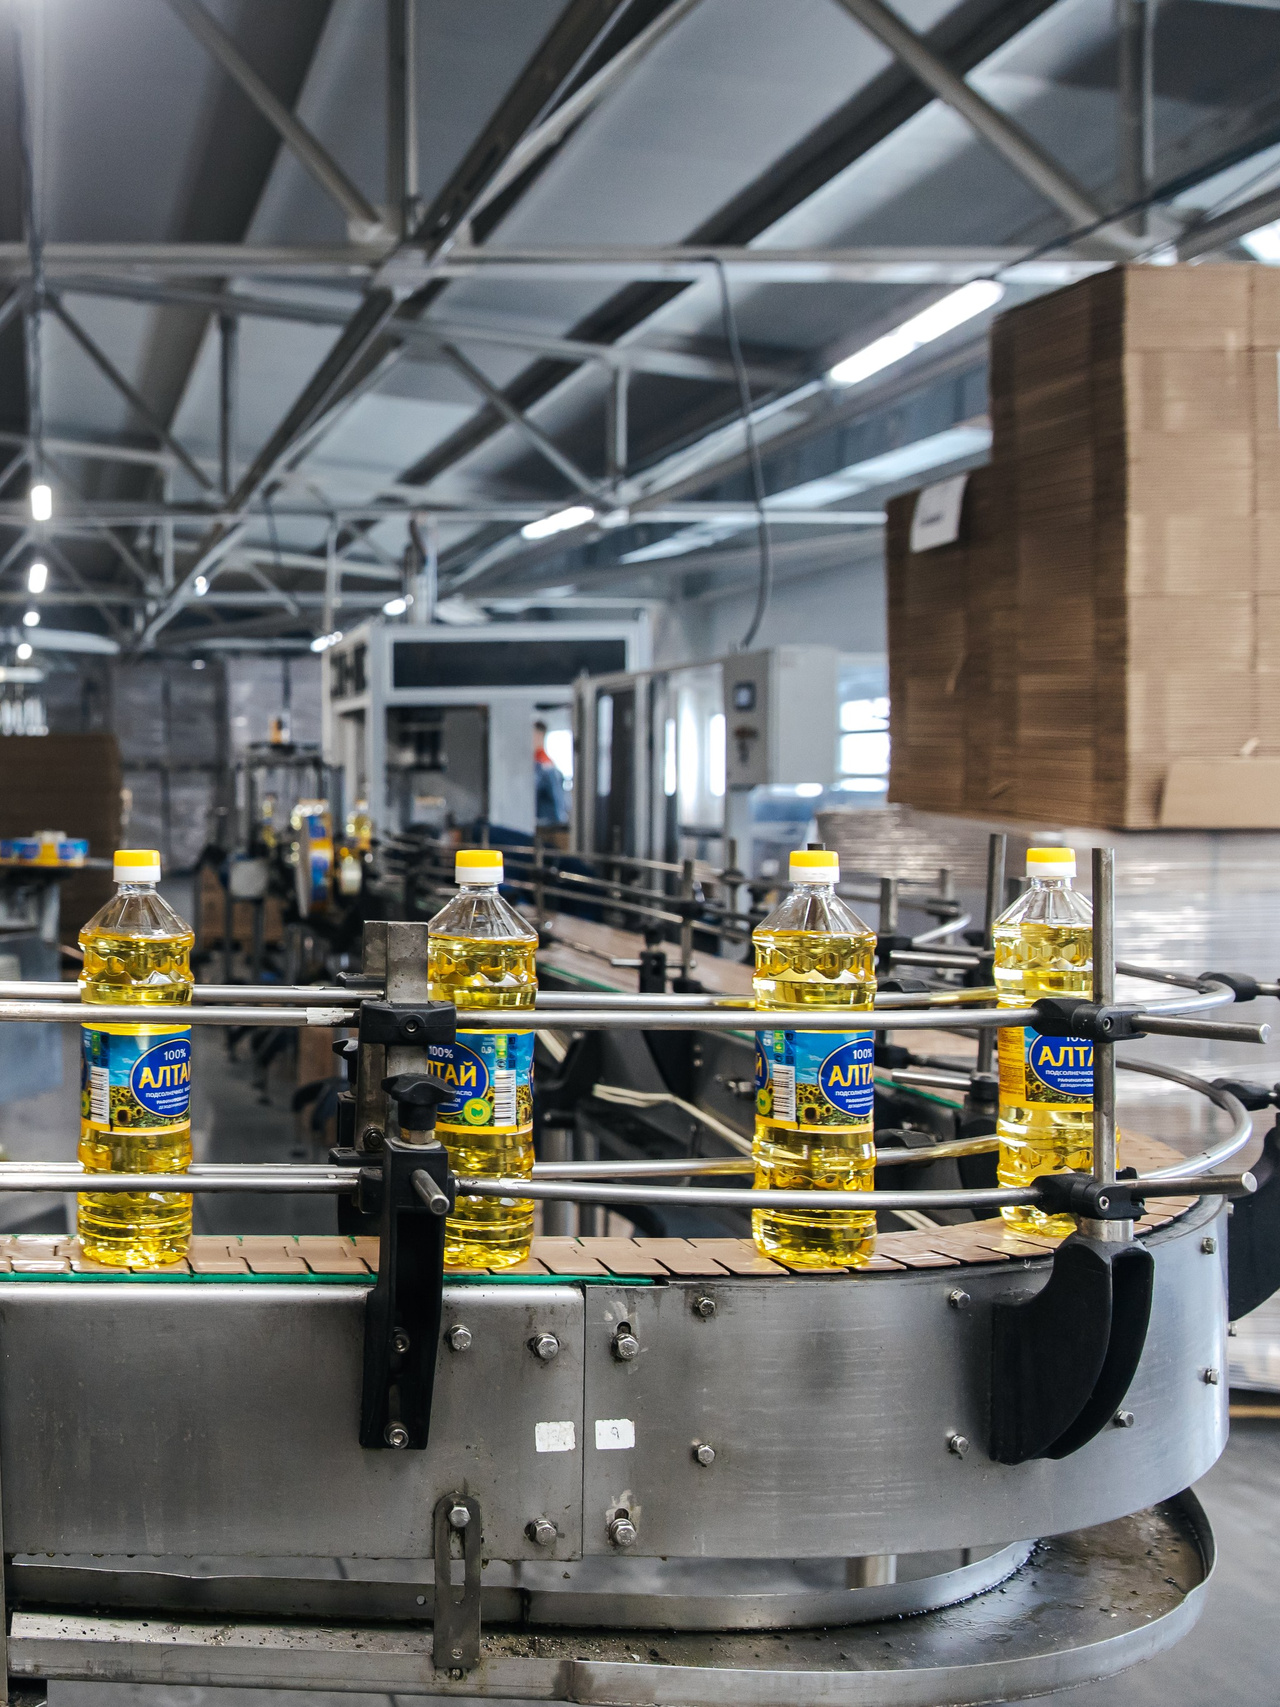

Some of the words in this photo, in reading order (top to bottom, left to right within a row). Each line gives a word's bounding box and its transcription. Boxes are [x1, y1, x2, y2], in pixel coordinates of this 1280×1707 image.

[164, 1048, 186, 1060] 100%
[428, 1045, 454, 1059] 100%
[852, 1048, 873, 1059] 100%
[1037, 1045, 1094, 1067] АЛТ
[427, 1060, 477, 1087] ЛТАЙ
[827, 1062, 874, 1087] АЛТА
